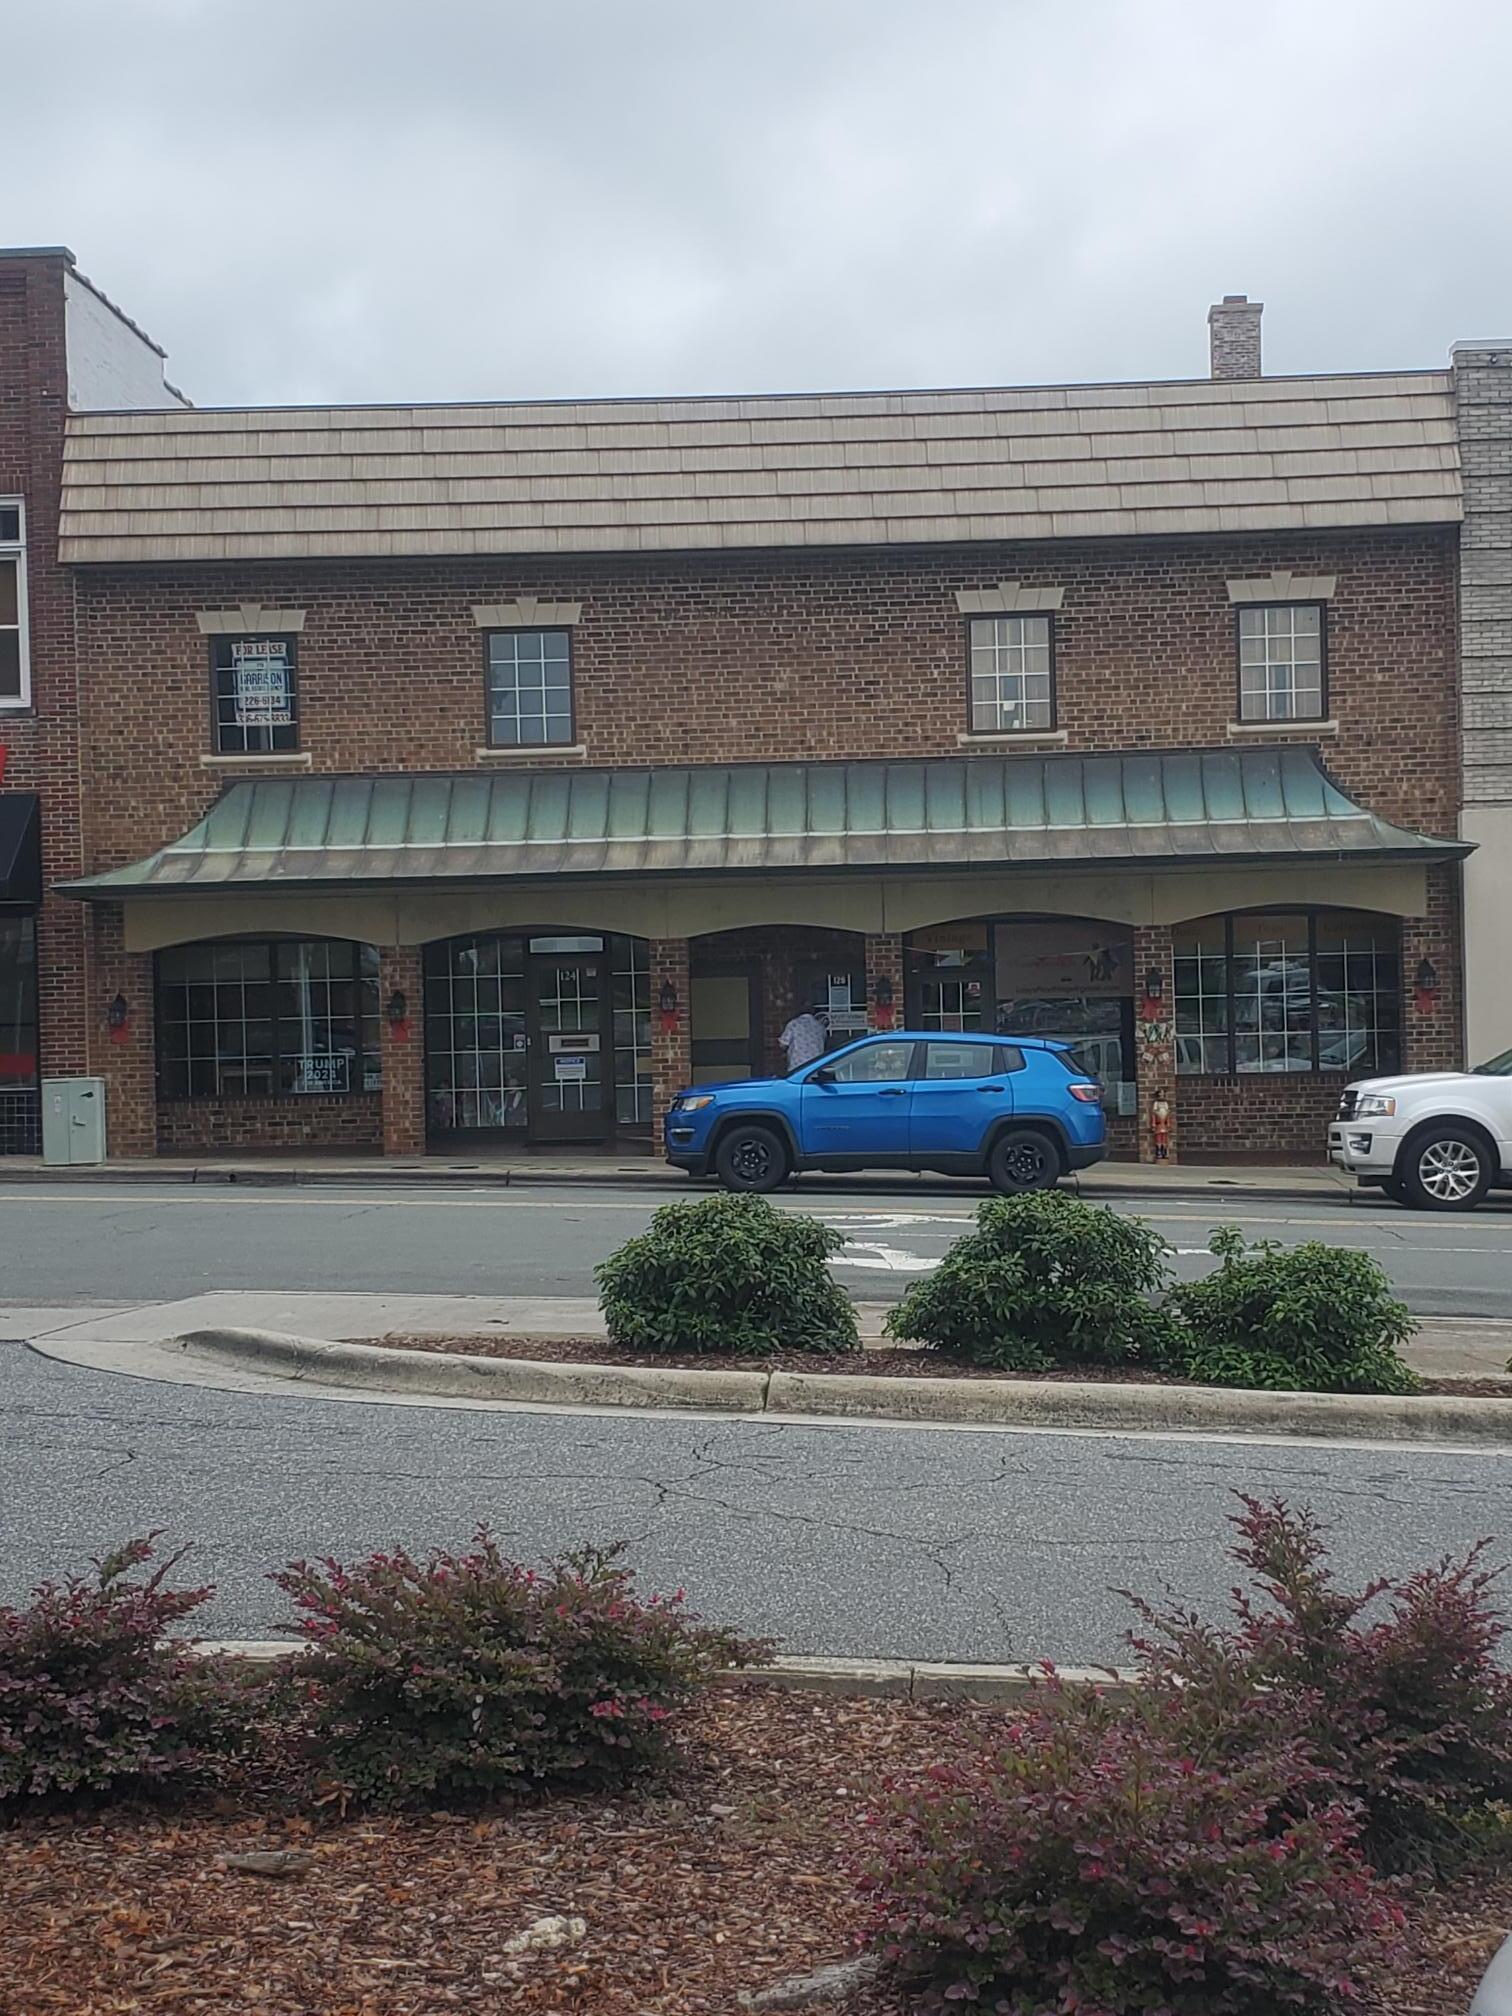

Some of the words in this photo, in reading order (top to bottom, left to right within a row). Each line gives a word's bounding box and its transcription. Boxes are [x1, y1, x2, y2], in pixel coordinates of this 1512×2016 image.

[236, 645, 253, 656] FOR
[256, 644, 284, 655] LEASE
[560, 970, 576, 981] 124
[298, 1058, 345, 1070] TRUMP
